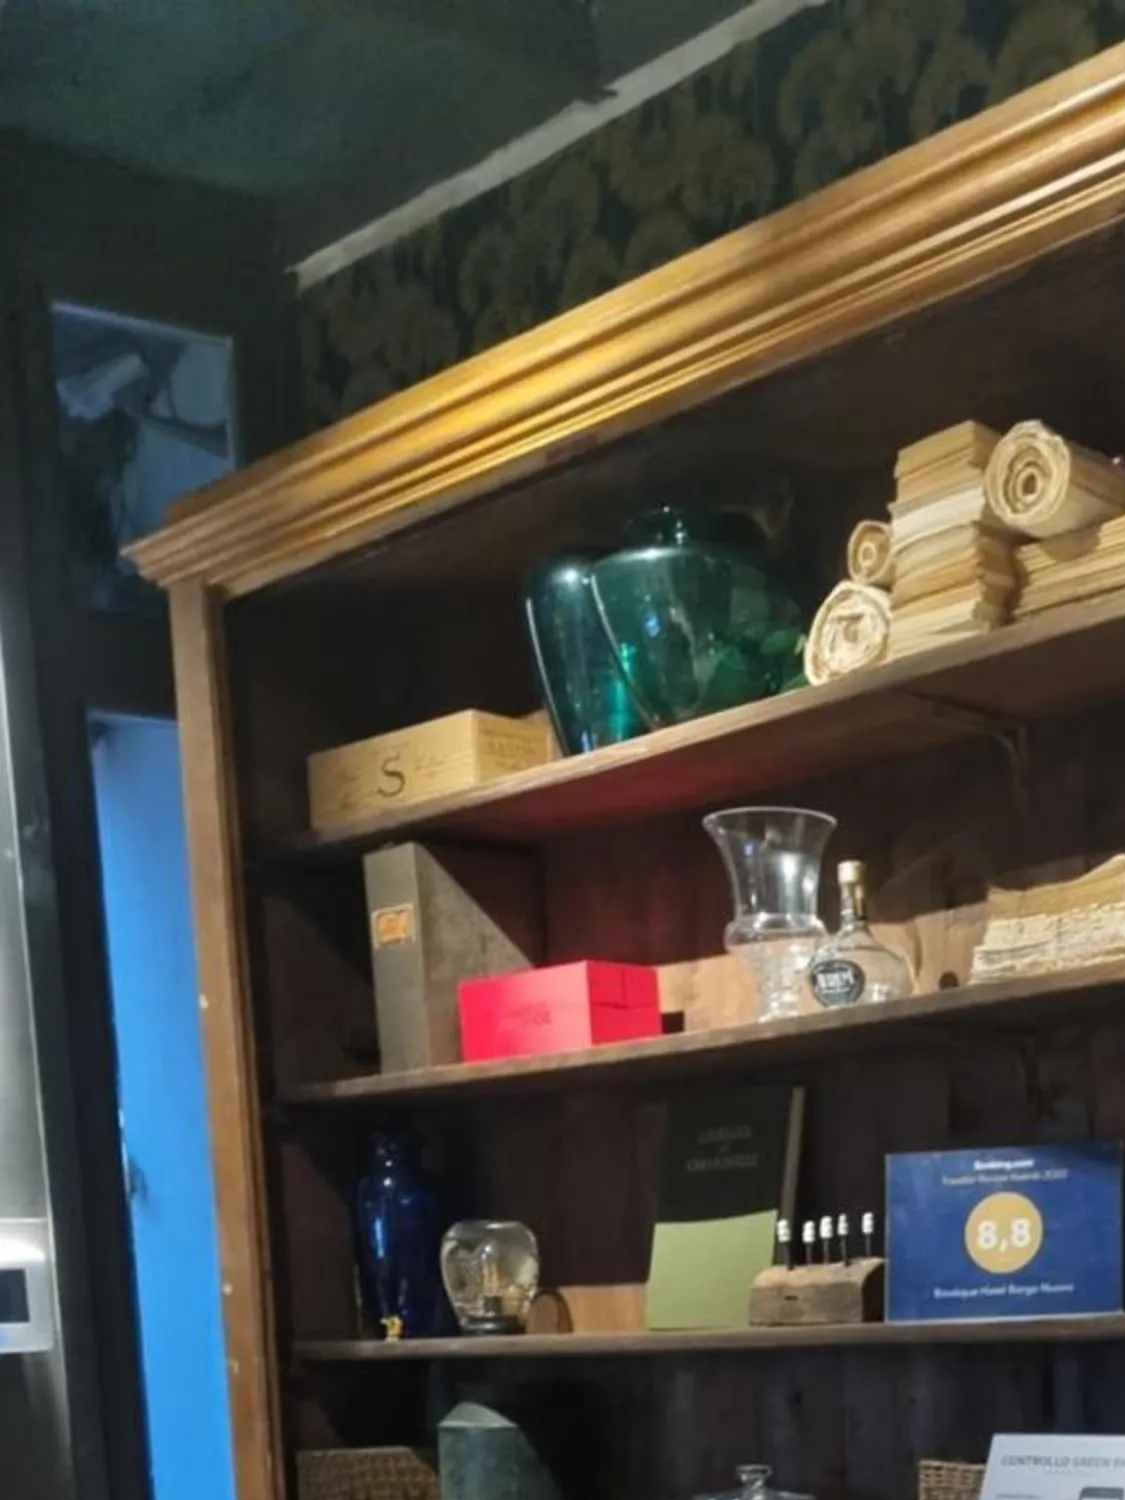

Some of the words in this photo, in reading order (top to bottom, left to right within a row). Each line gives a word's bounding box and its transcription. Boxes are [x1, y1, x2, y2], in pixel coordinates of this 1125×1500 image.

[377, 752, 406, 798] S
[977, 1217, 1032, 1250] 8,8
[1001, 1455, 1071, 1468] CONTROLLO
[1072, 1456, 1110, 1469] GREEN
